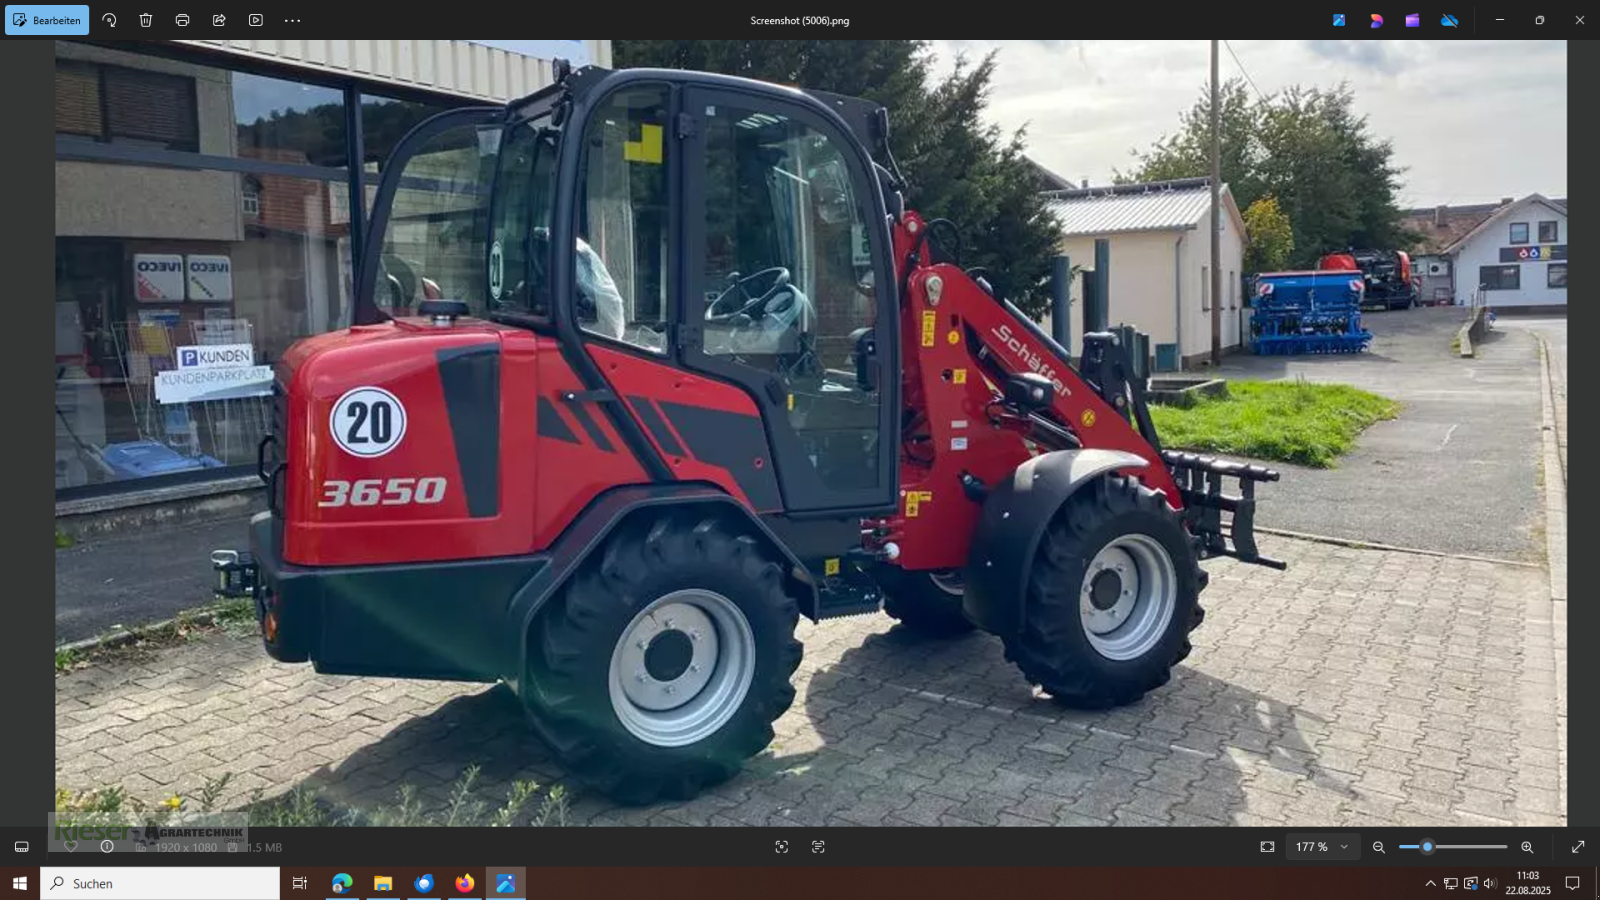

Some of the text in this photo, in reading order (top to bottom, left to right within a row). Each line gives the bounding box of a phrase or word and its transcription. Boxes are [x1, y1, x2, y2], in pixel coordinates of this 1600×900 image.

[33, 15, 81, 26] Bearbeiten
[750, 16, 850, 27] Screenshot (5006).png
[200, 350, 250, 363] KUNDEN
[991, 324, 1072, 397] Schäffer
[161, 368, 267, 386] KUNDENPARKPLATZ
[347, 401, 392, 444] 20
[318, 477, 447, 507] 3650
[155, 842, 218, 853] 1920 x 1080
[248, 842, 283, 853] 1.5 MB
[1295, 841, 1315, 852] 177
[1516, 871, 1540, 881] 11:03
[73, 878, 113, 890] Suchen
[1505, 886, 1551, 896] 22.08.2025
